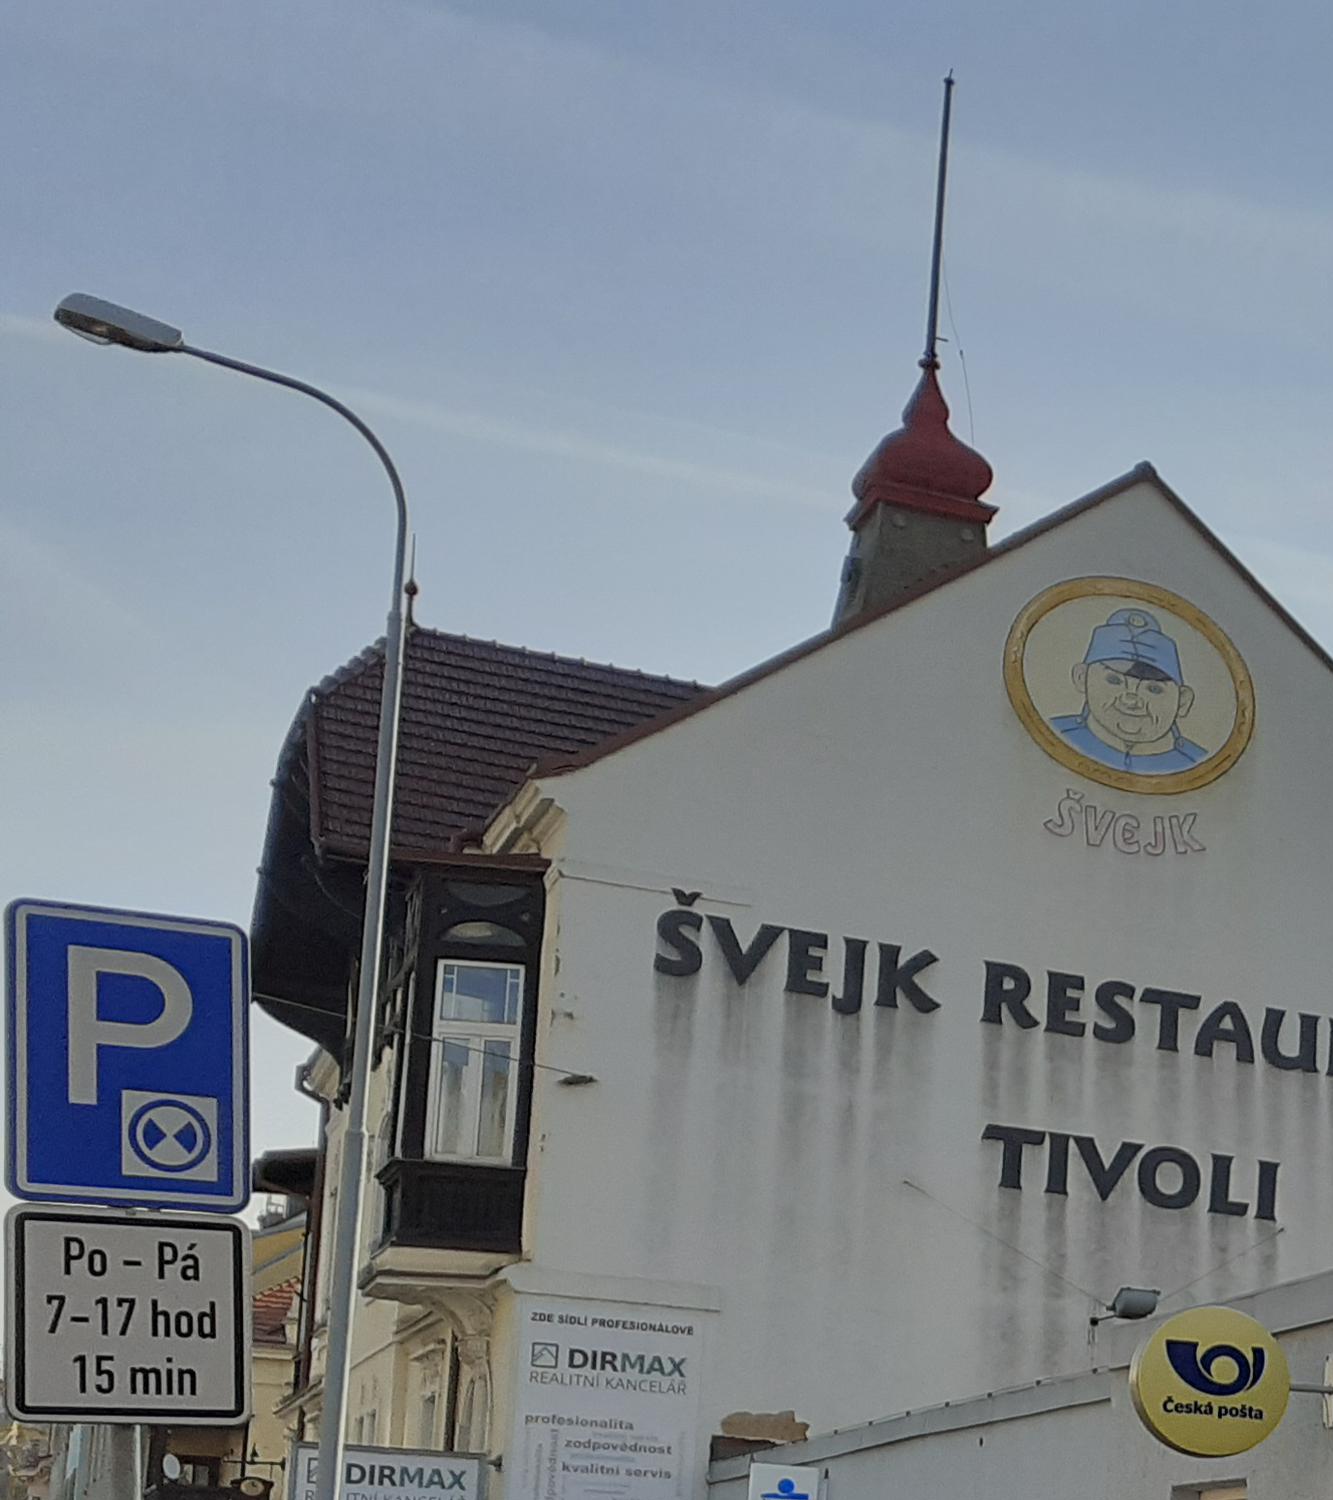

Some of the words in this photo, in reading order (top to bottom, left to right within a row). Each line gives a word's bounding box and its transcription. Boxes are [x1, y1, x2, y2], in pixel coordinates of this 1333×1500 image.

[1043, 789, 1206, 856] ŠVEJK
[653, 887, 942, 1015] ŠVEJK
[67, 944, 193, 1105] P
[981, 1123, 1281, 1221] TIVOLI
[63, 1236, 107, 1277] Po
[158, 1241, 200, 1281] Pá
[46, 1294, 136, 1336] 7-17
[151, 1299, 216, 1339] hod
[530, 1311, 554, 1323] ZDE
[72, 1354, 115, 1394] 15
[129, 1356, 197, 1396] min
[568, 1348, 688, 1378] DIRMAX
[529, 1371, 600, 1388] REALITNÍ
[605, 1376, 687, 1395] KANCELÁŘ
[524, 1413, 634, 1431] profesionalita
[1162, 1396, 1214, 1415] Česká
[1217, 1404, 1264, 1420] pošta
[345, 1462, 467, 1491] DIRMAX
[624, 1467, 672, 1480] servis
